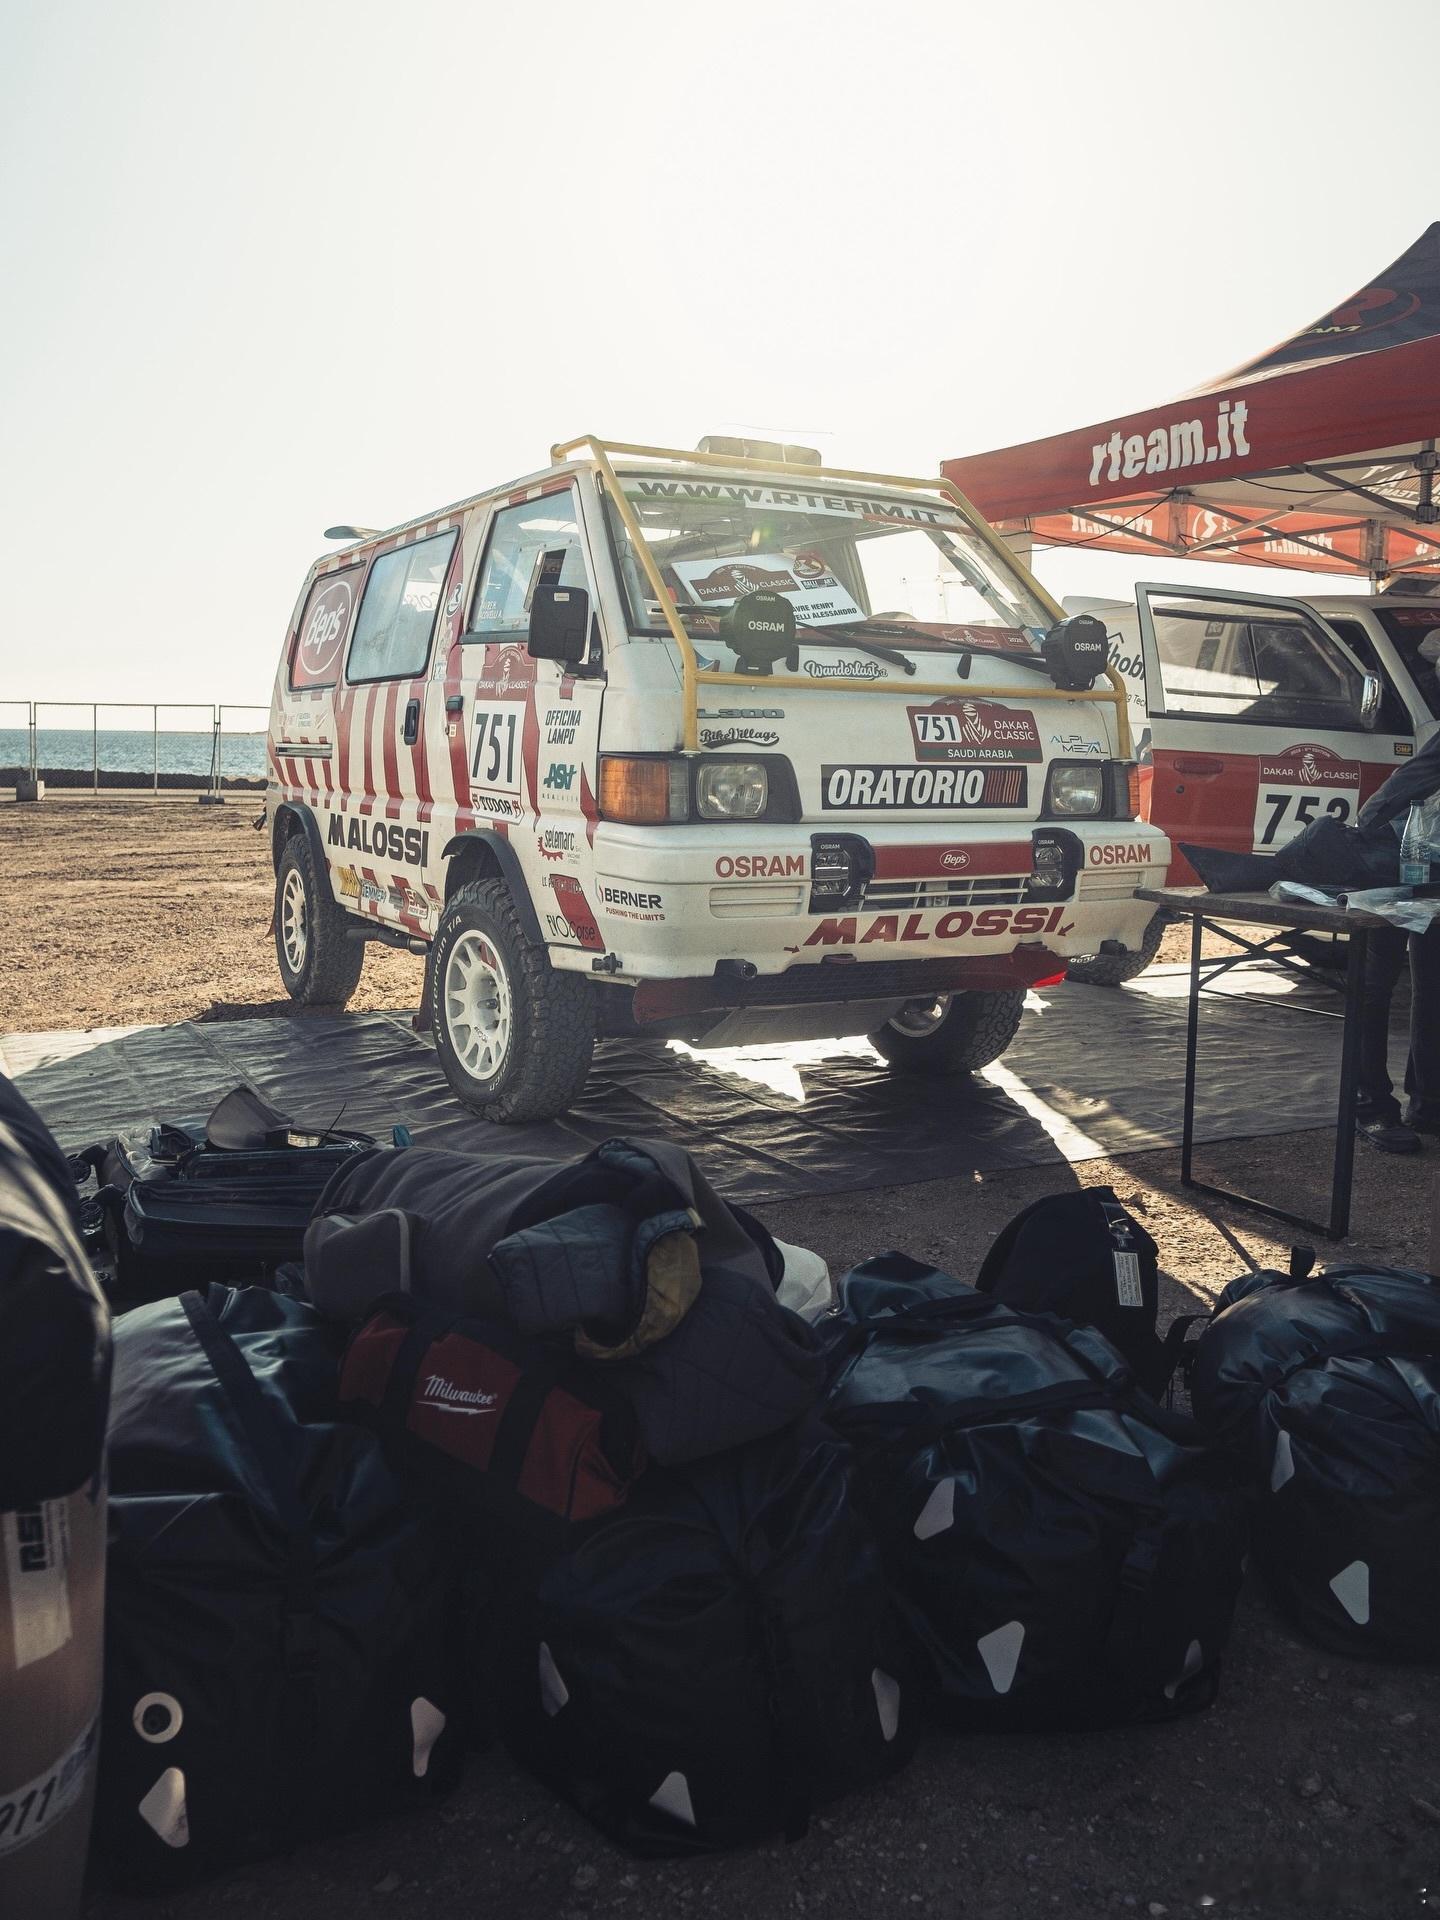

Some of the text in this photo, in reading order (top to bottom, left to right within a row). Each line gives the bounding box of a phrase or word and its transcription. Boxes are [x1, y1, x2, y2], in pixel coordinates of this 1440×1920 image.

[1089, 400, 1250, 486] rteam.it
[638, 482, 940, 524] WWW.RTEAM.IT
[698, 578, 794, 595] DAKAR CLASSIC
[811, 602, 834, 611] HENRY
[812, 607, 857, 619] ALESSANDRO
[748, 620, 785, 632] OSRAM
[1074, 642, 1101, 651] OSRAM
[545, 710, 582, 726] OFFICINA
[697, 708, 785, 719] L300
[917, 716, 956, 741] 751
[994, 720, 1030, 730] DAKAR
[547, 728, 575, 744] LAMPO
[994, 730, 1035, 741] CLASSIC
[472, 713, 516, 783] 751
[947, 749, 1014, 759] SAUDI ARABIA
[1263, 767, 1359, 780] DAKAR CLASSIC
[827, 769, 984, 806] ORATORIO
[479, 796, 512, 813] TUDOR
[328, 813, 429, 868] MALOSSI
[943, 854, 966, 866] Bep's
[1089, 843, 1151, 866] OSRAM
[716, 855, 804, 878] OSRAM
[604, 887, 663, 909] BERNER
[606, 907, 666, 921] PUSHING THE LIMITS
[802, 906, 1066, 946] MALOSSI
[424, 1374, 494, 1406] Milwaukee
